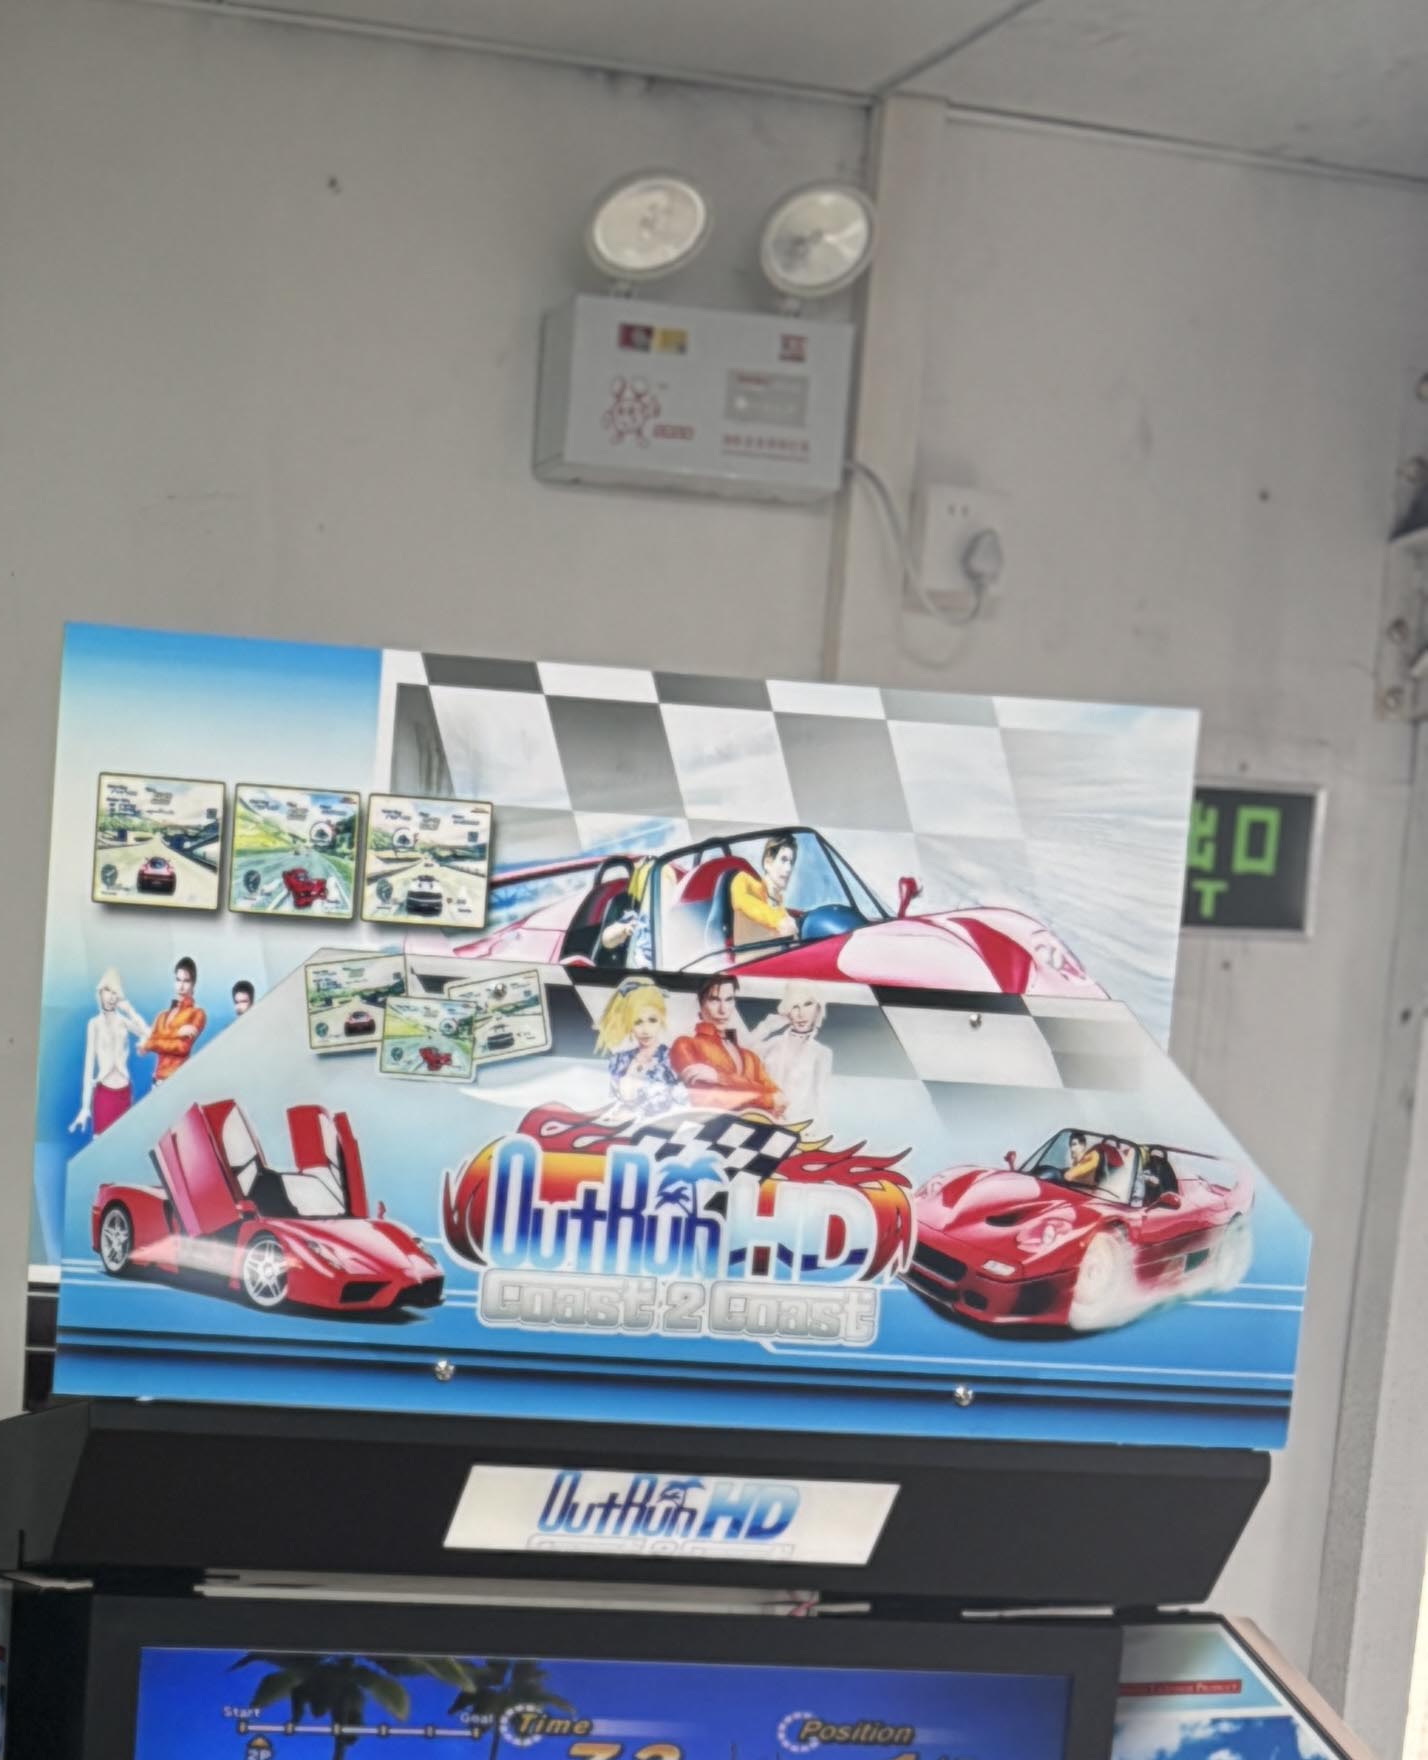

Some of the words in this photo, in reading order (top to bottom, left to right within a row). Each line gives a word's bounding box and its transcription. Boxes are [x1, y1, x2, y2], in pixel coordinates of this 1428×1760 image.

[728, 1177, 878, 1284] HD
[482, 1270, 656, 1331] Coast
[662, 1282, 706, 1333] 2
[710, 1281, 878, 1344] Coast
[699, 1481, 802, 1541] HD
[518, 1712, 592, 1736] Time
[800, 1717, 914, 1745] Position
